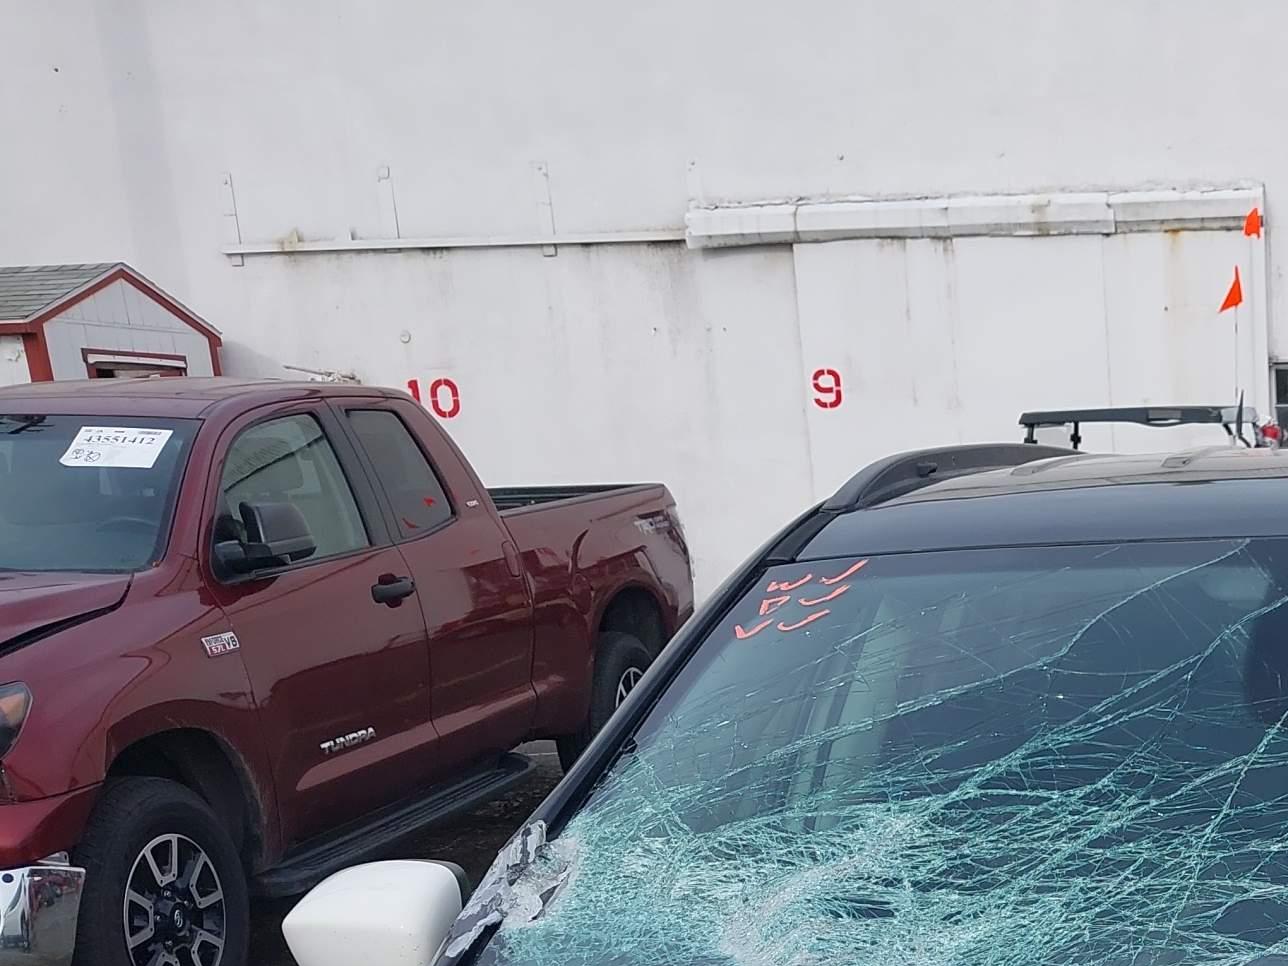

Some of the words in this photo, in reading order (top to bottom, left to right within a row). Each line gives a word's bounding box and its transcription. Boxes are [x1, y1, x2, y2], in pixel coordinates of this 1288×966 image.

[406, 378, 460, 418] 10
[813, 368, 842, 410] 9
[84, 435, 155, 445] 43551412
[319, 726, 377, 755] TUNDRA
